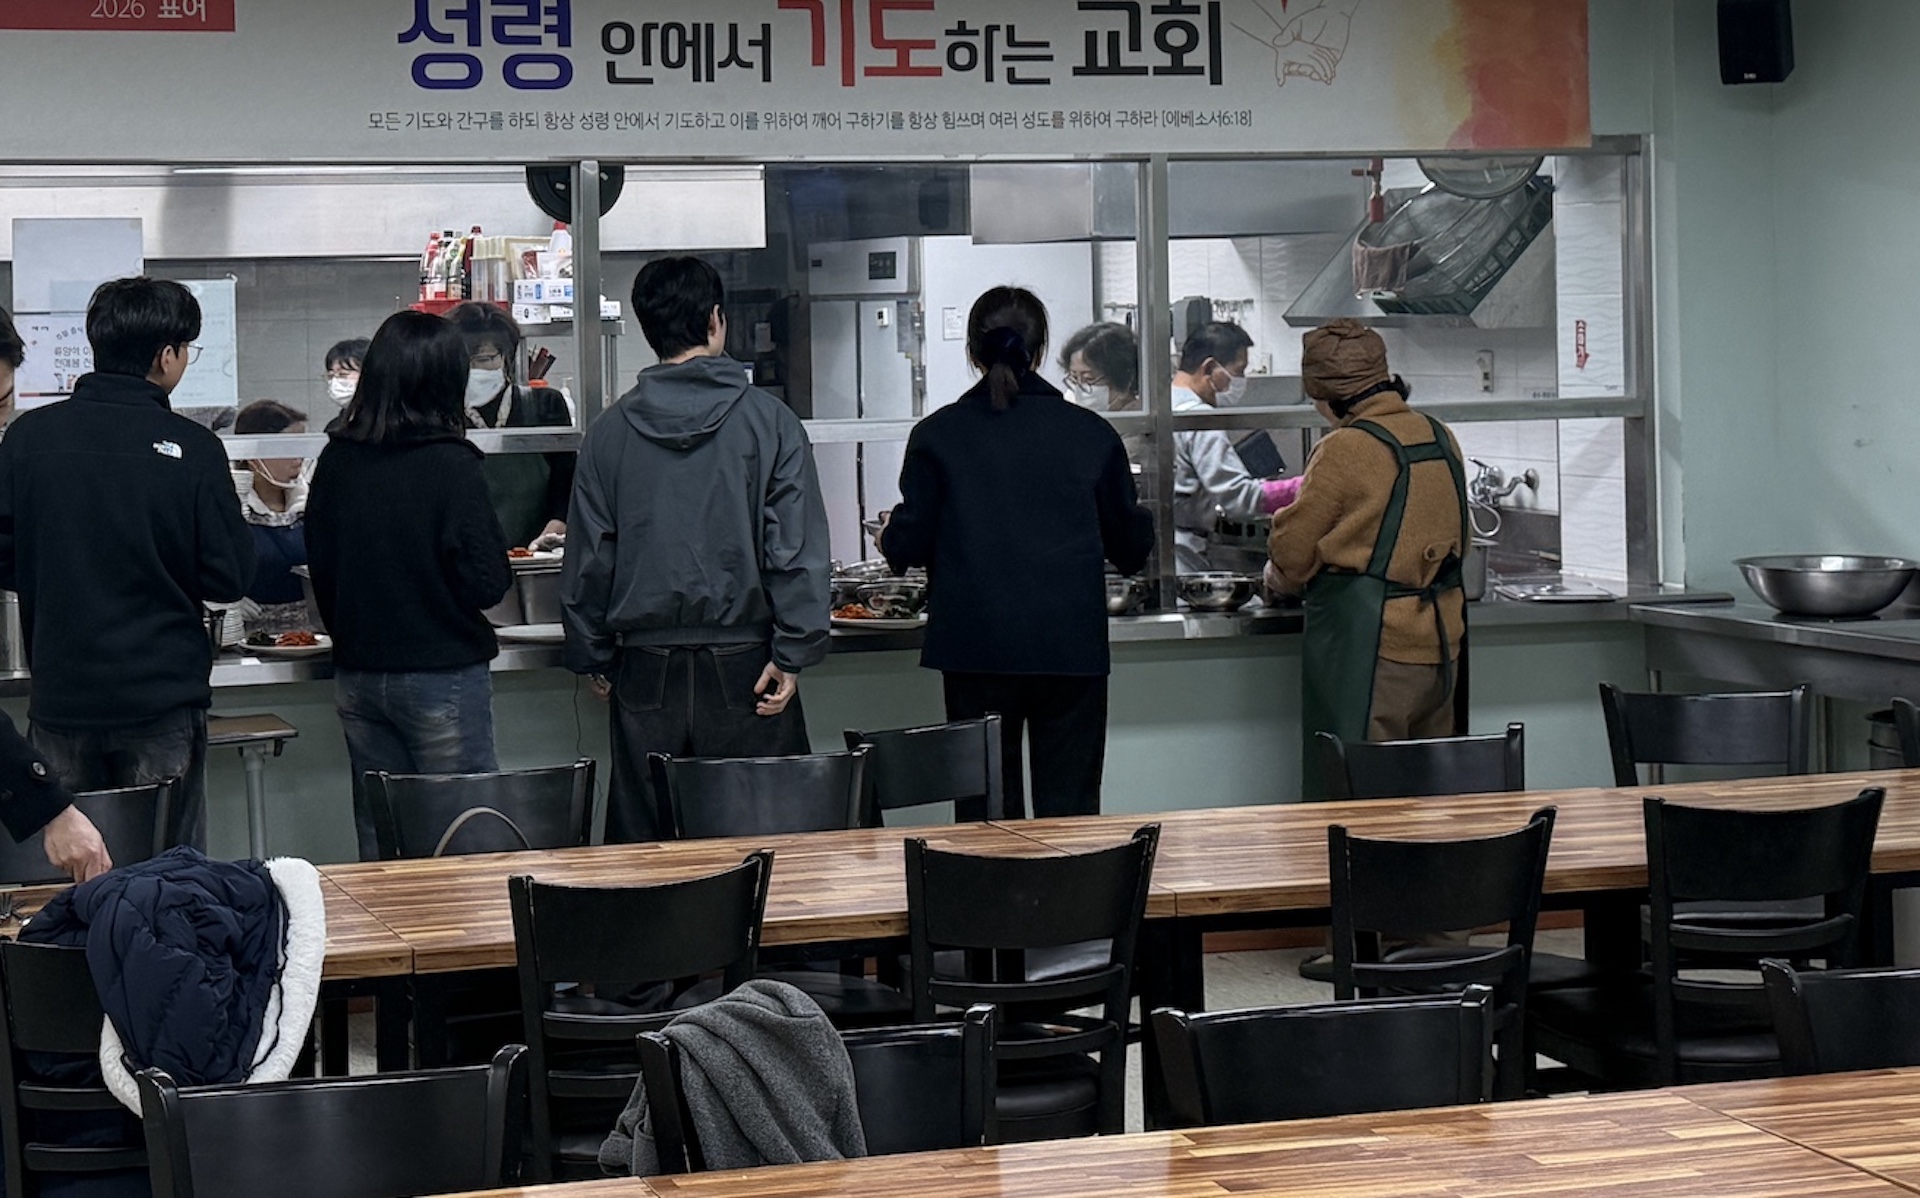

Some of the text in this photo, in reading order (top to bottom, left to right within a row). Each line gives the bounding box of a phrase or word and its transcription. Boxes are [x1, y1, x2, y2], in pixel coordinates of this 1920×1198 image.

[90, 0, 206, 22] 2026 표어
[397, 0, 1223, 90] 성령 안에서 기도하는 교회
[369, 110, 1252, 131] 모든 기도와 간구를 하되 항상 성령 안에서 기도하고 이를 위하여 깨어 구하기를 항상 힘쓰며 여러 성도를 위하여 구하라 [에베소서6:18]
